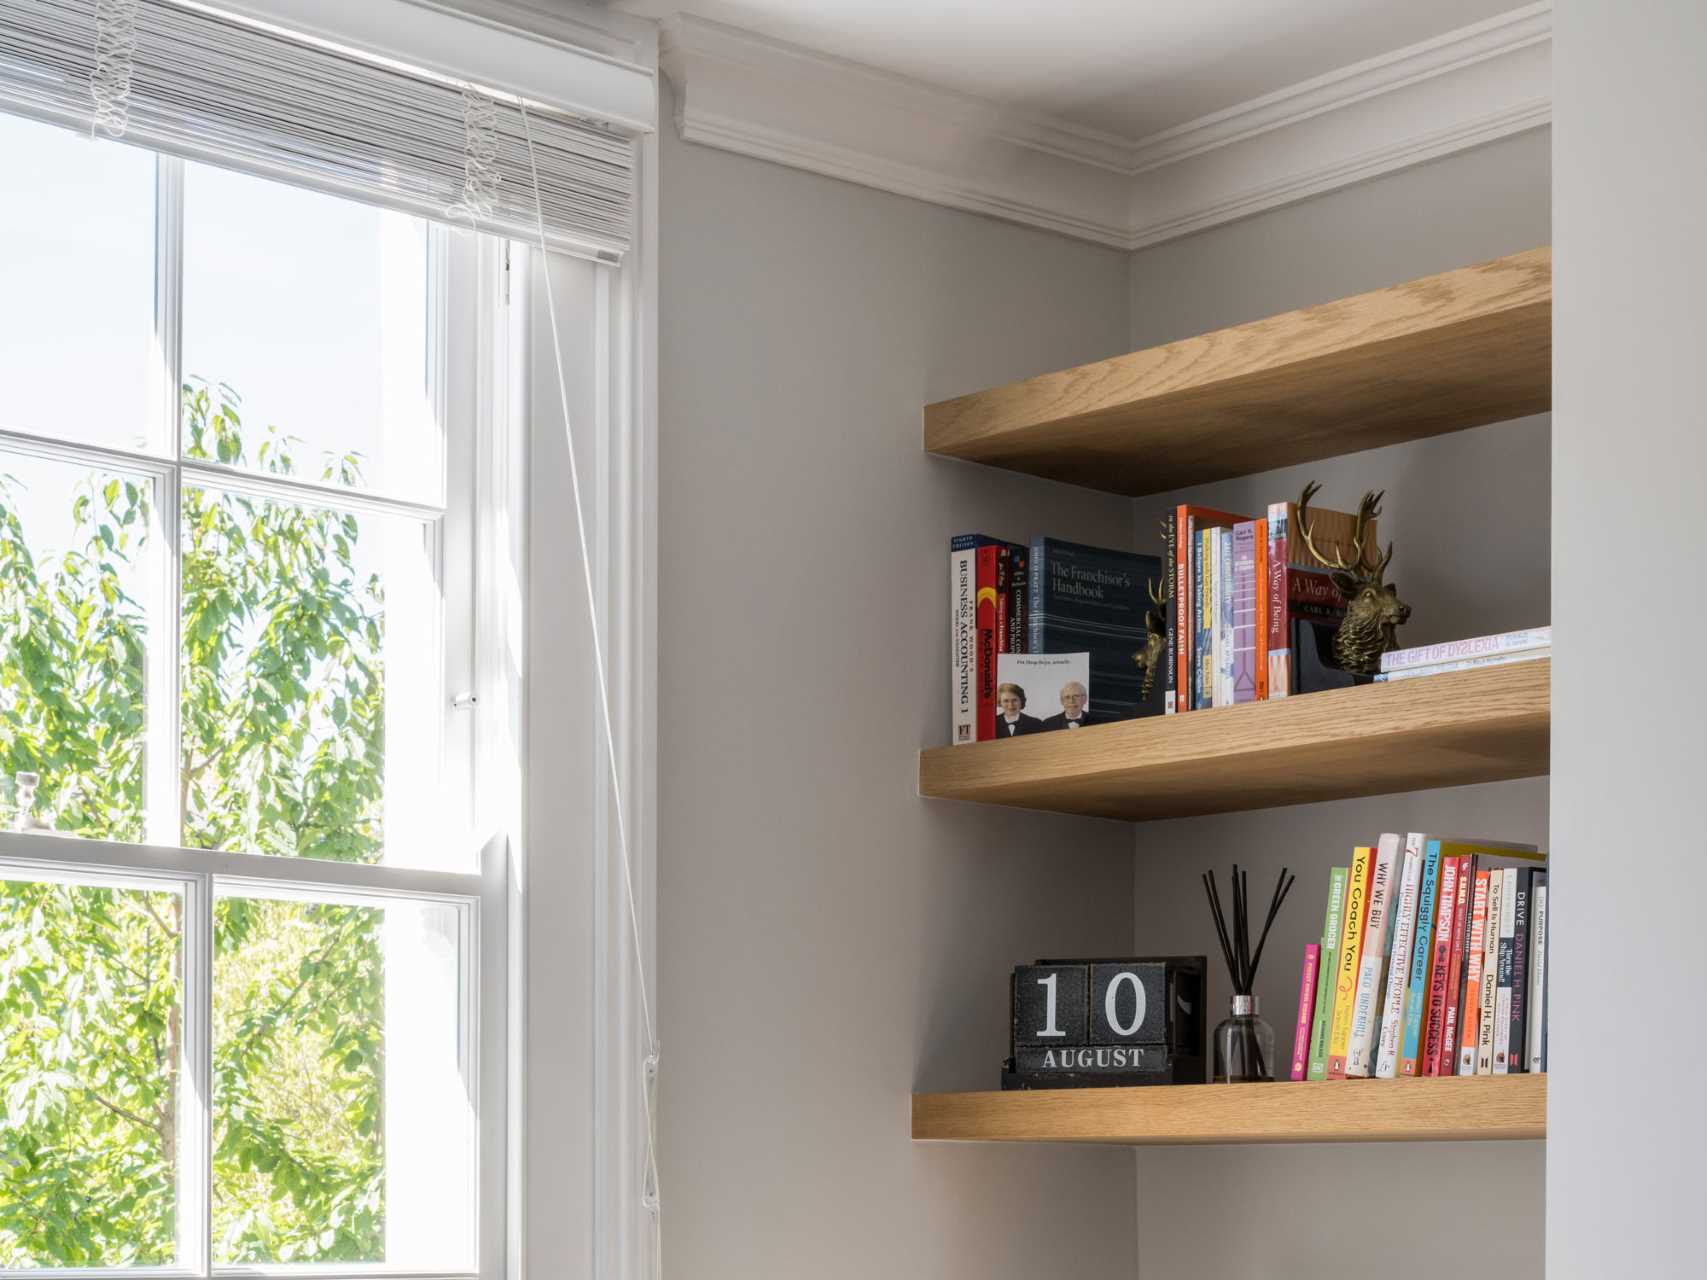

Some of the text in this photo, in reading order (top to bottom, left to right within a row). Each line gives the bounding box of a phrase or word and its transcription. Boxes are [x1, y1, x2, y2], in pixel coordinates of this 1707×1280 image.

[959, 560, 967, 618] BUSINESS
[1051, 560, 1131, 589] The Franchisor's
[1052, 578, 1104, 599] Handbook
[1293, 576, 1302, 593] A
[1305, 578, 1328, 600] Way
[1194, 583, 1202, 607] Taking
[1270, 559, 1281, 633] A Way of Being
[960, 621, 969, 704] ACCOUNTING
[1386, 653, 1406, 667] THE
[1407, 649, 1430, 664] GIFT
[1432, 646, 1447, 659] OF
[1405, 845, 1418, 857] 7
[1426, 852, 1437, 876] The
[1330, 881, 1341, 911] GREEN
[1368, 861, 1388, 929] WHY WE BUY
[1399, 883, 1414, 922] HIGHLY
[1418, 878, 1434, 932] Squiggly
[1437, 863, 1456, 942] JOHN TIMPSON
[1492, 884, 1499, 893] To
[1343, 855, 1366, 971] You Coach You
[1491, 913, 1497, 921] Is
[1516, 891, 1525, 926] DRIVE
[1326, 913, 1338, 949] GROCER
[1467, 877, 1487, 982] START WITH WHY
[1488, 922, 1497, 954] Human
[1394, 922, 1410, 974] EFFECTIVE
[1414, 935, 1428, 981] Career
[1514, 932, 1524, 975] DANIEL
[1361, 966, 1373, 988] PACO
[1389, 976, 1404, 1014] PEOPLE
[1426, 964, 1446, 1056] KEYS TO SUCCESS
[1481, 974, 1494, 1046] Daniel H. Pink
[1512, 993, 1521, 1021] PINK
[1353, 991, 1370, 1038] UNDERHILL
[1446, 1006, 1455, 1025] PAUL
[1443, 1026, 1453, 1052] McGEE
[1043, 1049, 1144, 1069] AUGUST
